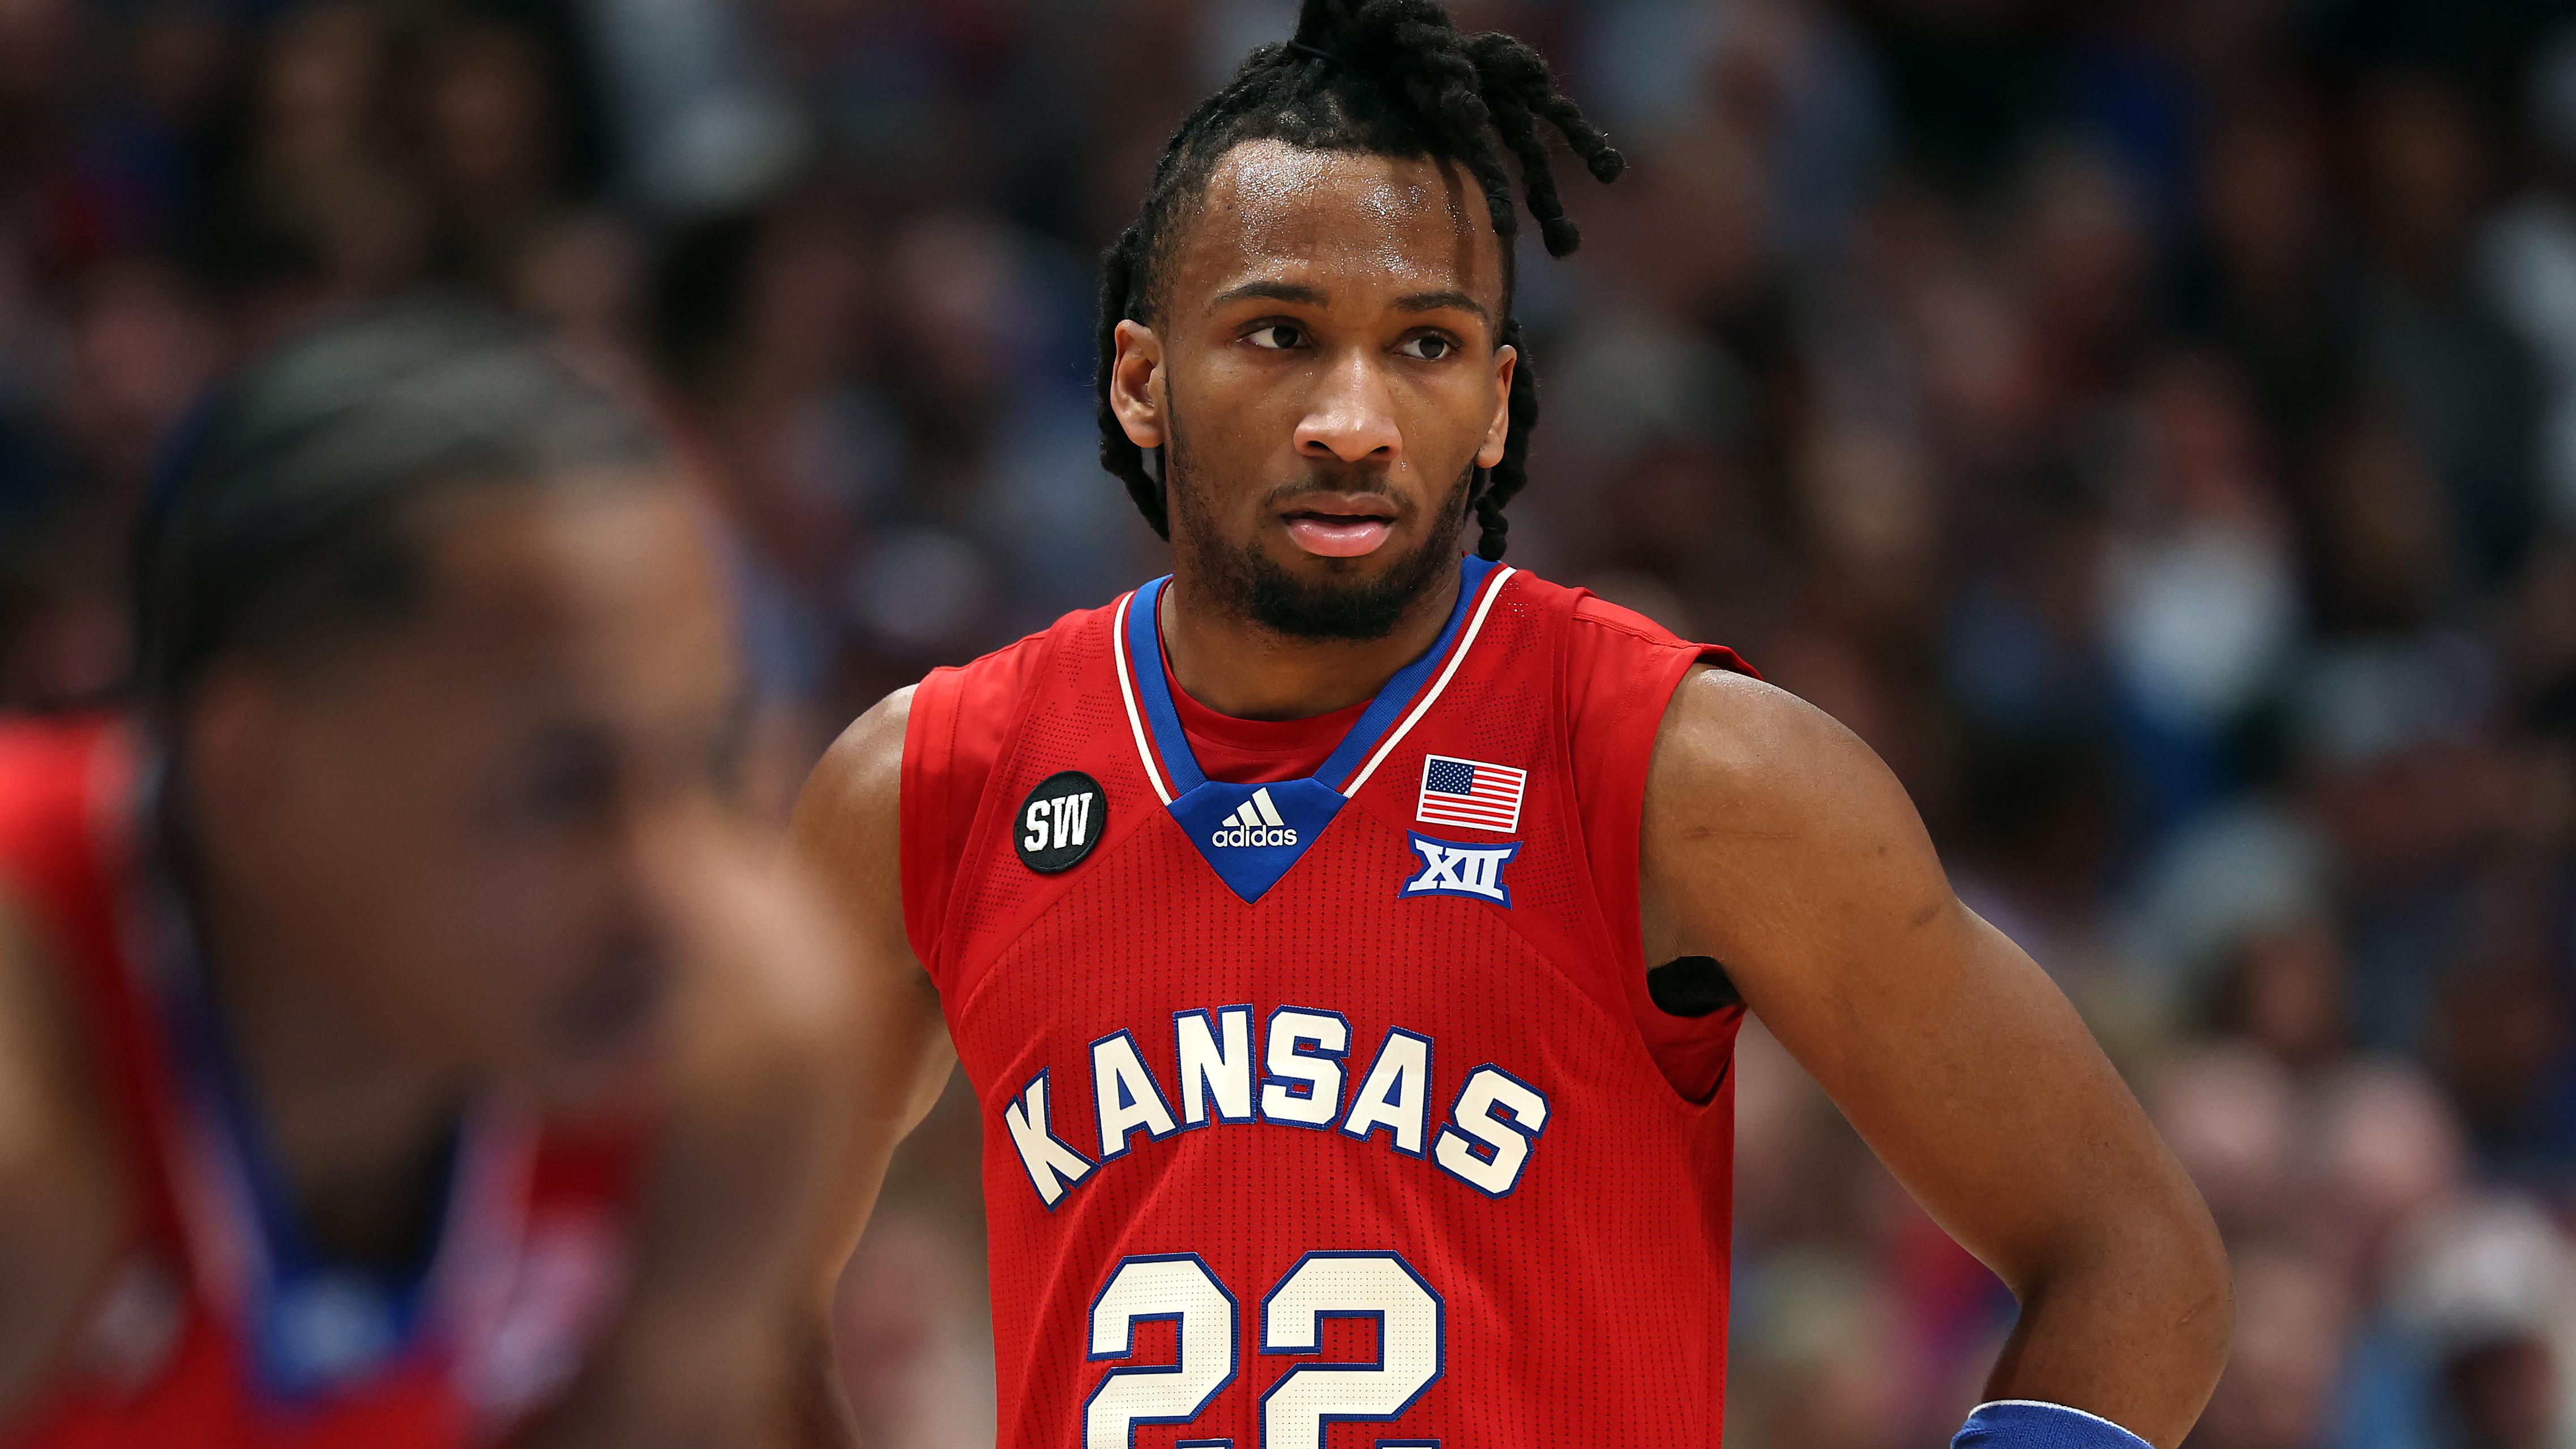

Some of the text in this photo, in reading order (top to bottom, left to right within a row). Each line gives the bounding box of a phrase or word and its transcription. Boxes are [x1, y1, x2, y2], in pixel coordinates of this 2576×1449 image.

[1024, 792, 1093, 852] SW
[1212, 824, 1297, 847] adidas
[1407, 839, 1513, 901] XII
[1004, 1004, 1551, 1212] KANSAS
[1082, 1250, 1444, 1449] 22
